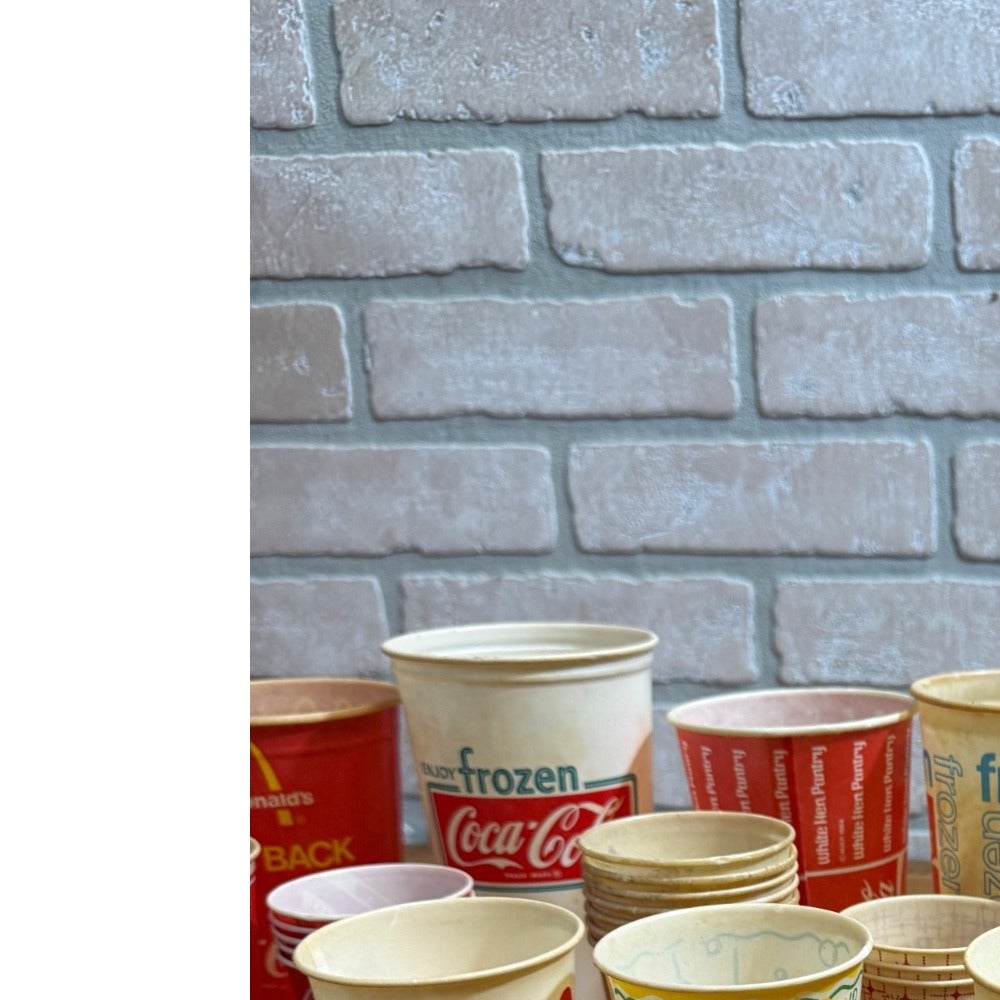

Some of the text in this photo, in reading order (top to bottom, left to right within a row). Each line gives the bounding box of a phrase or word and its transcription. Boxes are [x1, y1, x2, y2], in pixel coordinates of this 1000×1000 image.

[421, 747, 580, 796] ENJOY frozen
[811, 745, 830, 865] White Hen Pantry
[851, 740, 867, 860] White Hen Pantry
[263, 836, 356, 872] BACK
